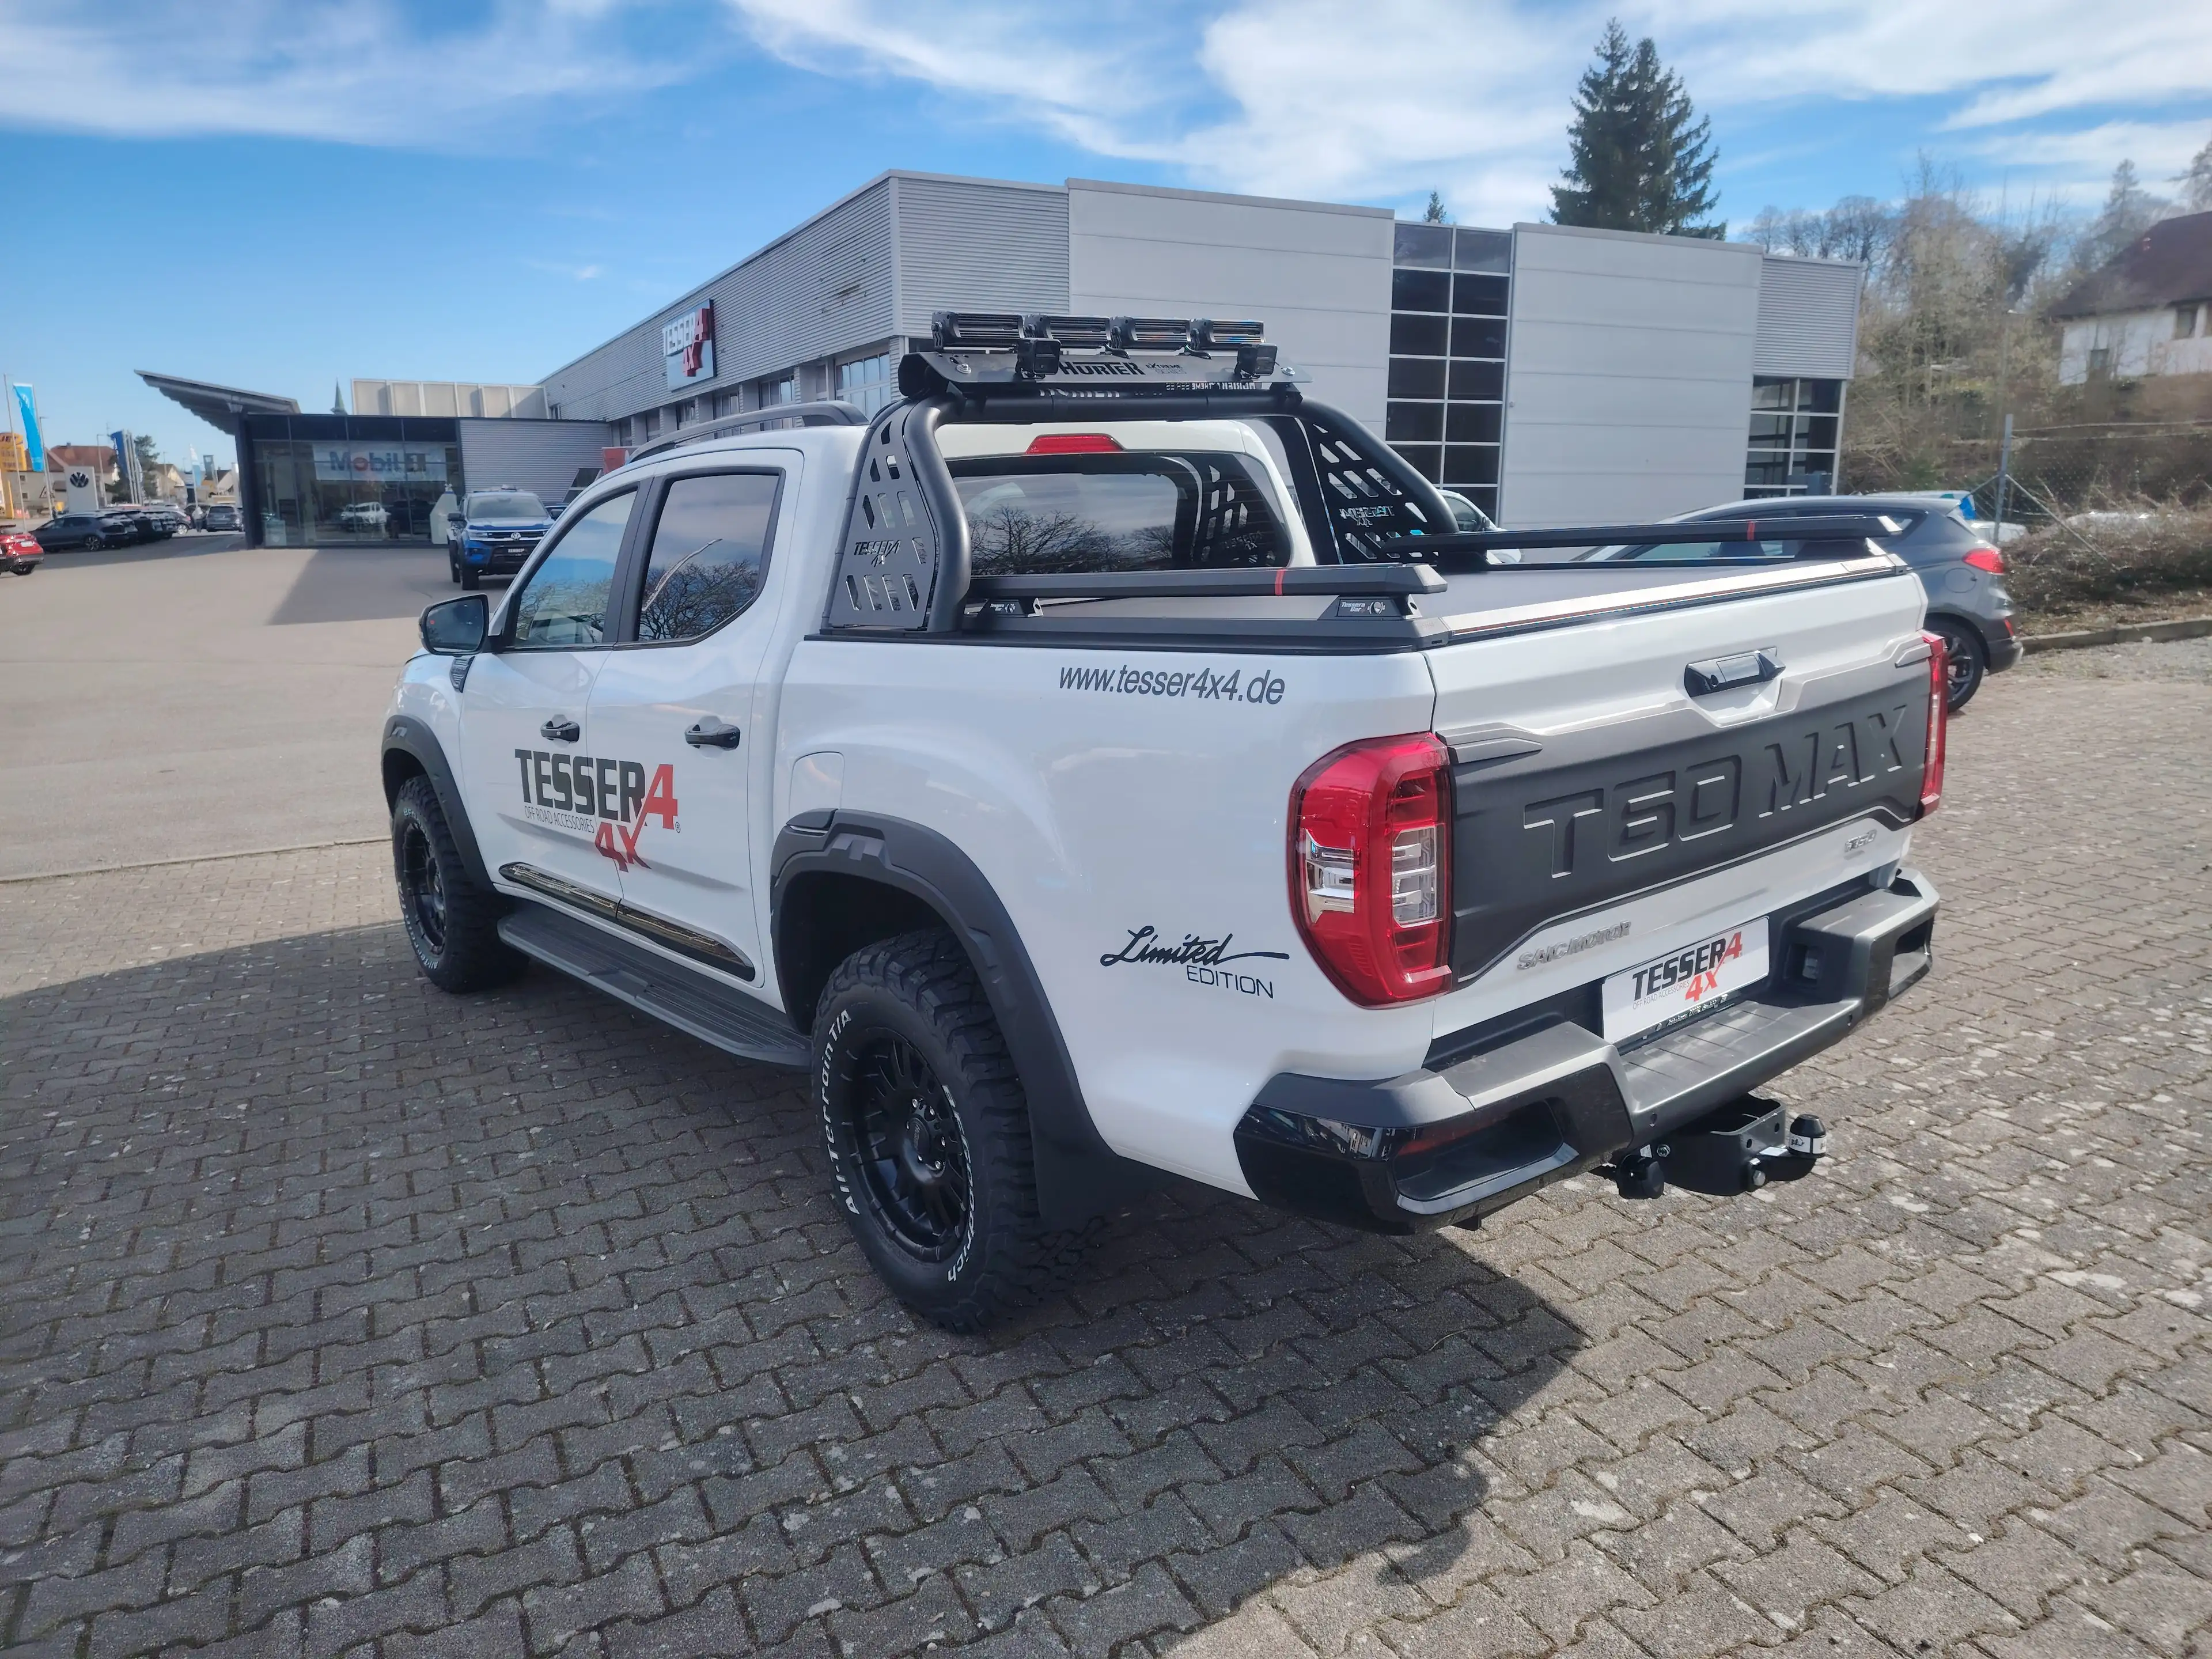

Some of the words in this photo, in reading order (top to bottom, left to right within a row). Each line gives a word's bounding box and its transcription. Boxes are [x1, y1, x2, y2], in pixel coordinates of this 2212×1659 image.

[1059, 362, 1146, 375] HURTER
[329, 452, 401, 472] Mobil
[1059, 665, 1285, 704] www.tesser4x4.de
[1524, 755, 1742, 878] T60
[1759, 704, 1907, 819] MAX
[525, 806, 535, 819] OFF
[536, 808, 553, 824] ROAD
[554, 812, 594, 834] ACCESSORIES
[1100, 925, 1290, 967] Limited
[1186, 965, 1274, 999] EDITION
[1633, 1000, 1643, 1010] OFF
[1643, 993, 1657, 1005] ROAD
[1658, 980, 1690, 998] ACCESSORIES
[828, 1009, 851, 1041] T/A
[821, 1042, 861, 1215] All-Terrain
